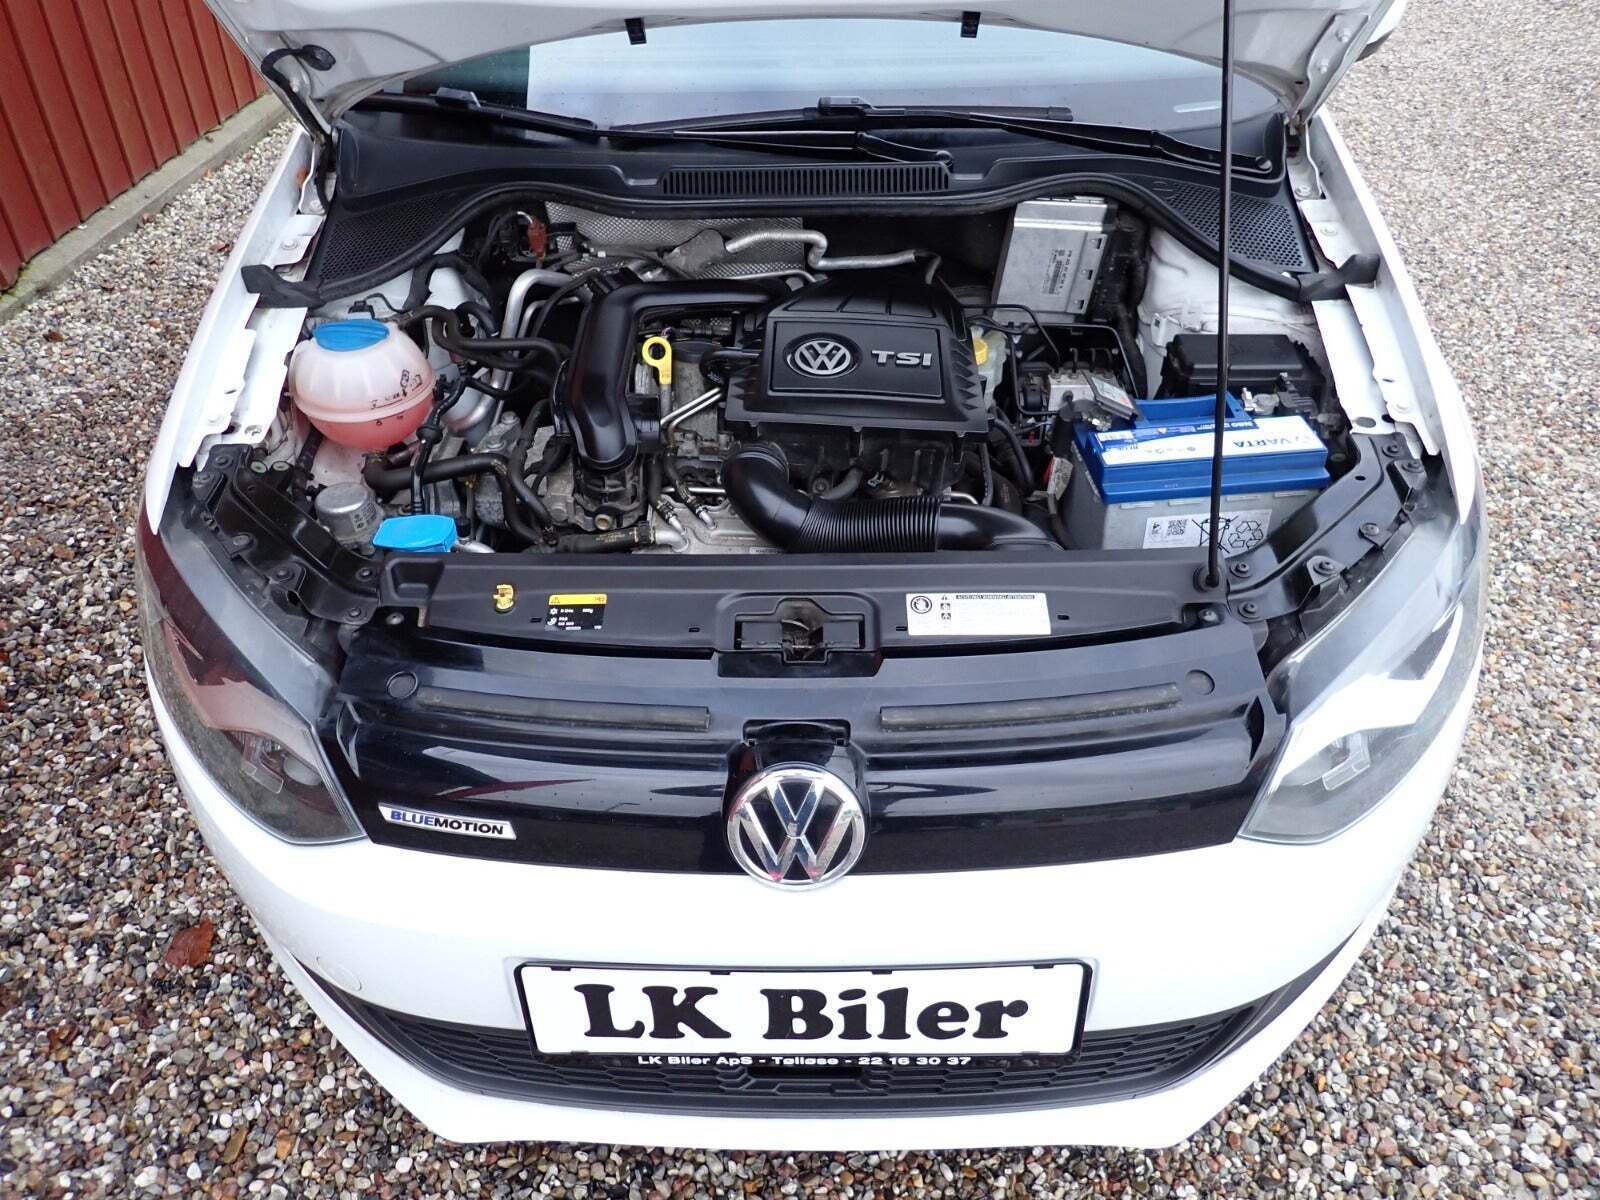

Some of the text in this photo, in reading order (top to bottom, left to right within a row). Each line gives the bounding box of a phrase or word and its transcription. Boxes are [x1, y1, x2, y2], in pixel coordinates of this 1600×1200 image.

[871, 350, 932, 366] TSI
[390, 810, 503, 835] BLUEMOTION
[575, 984, 1028, 1040] LK Biler
[637, 1056, 662, 1065] LK
[716, 1056, 753, 1067] ApS
[858, 1056, 883, 1065] 22
[889, 1056, 910, 1065] 16
[916, 1056, 941, 1065] 30
[947, 1056, 971, 1065] 37
